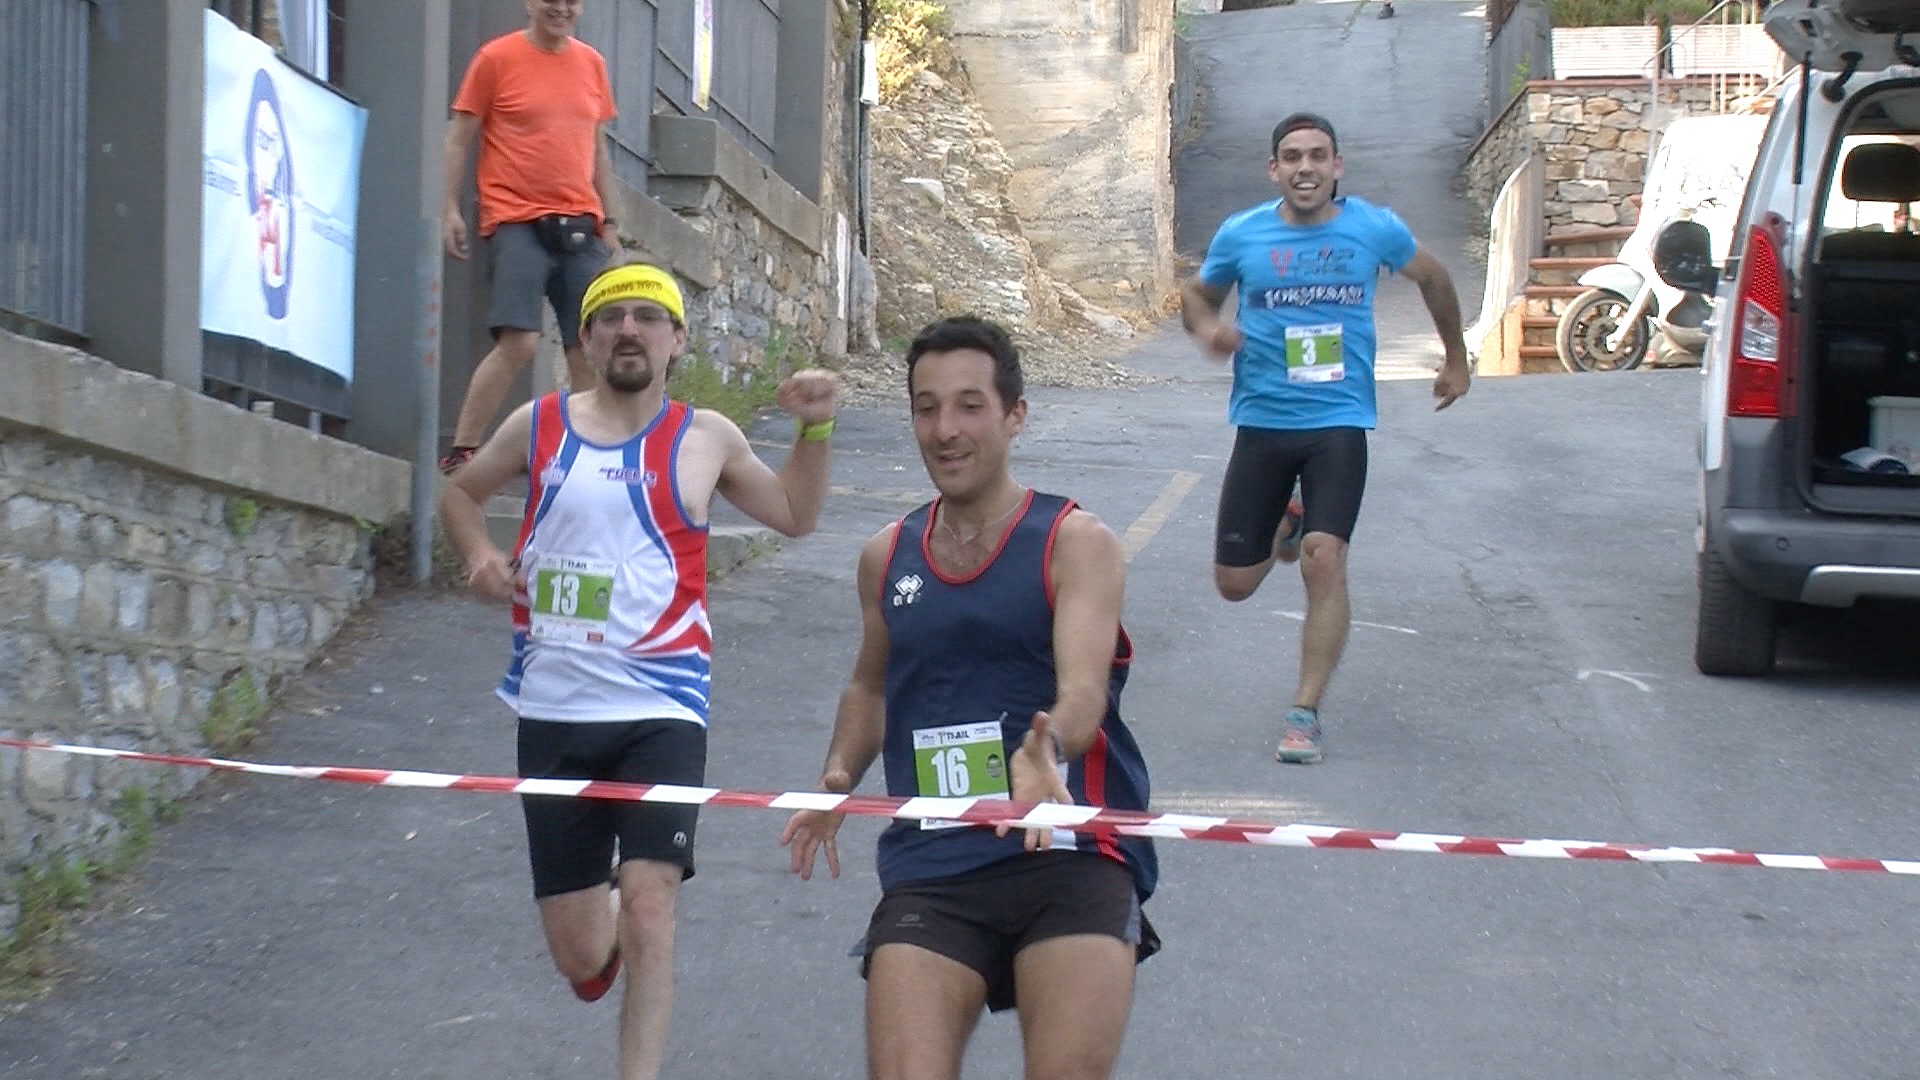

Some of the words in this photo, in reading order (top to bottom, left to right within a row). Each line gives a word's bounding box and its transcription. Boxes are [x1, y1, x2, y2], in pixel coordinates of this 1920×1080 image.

[1301, 338, 1317, 366] 3
[550, 574, 580, 616] 13
[946, 729, 970, 742] TRAIL
[931, 747, 970, 797] 16
